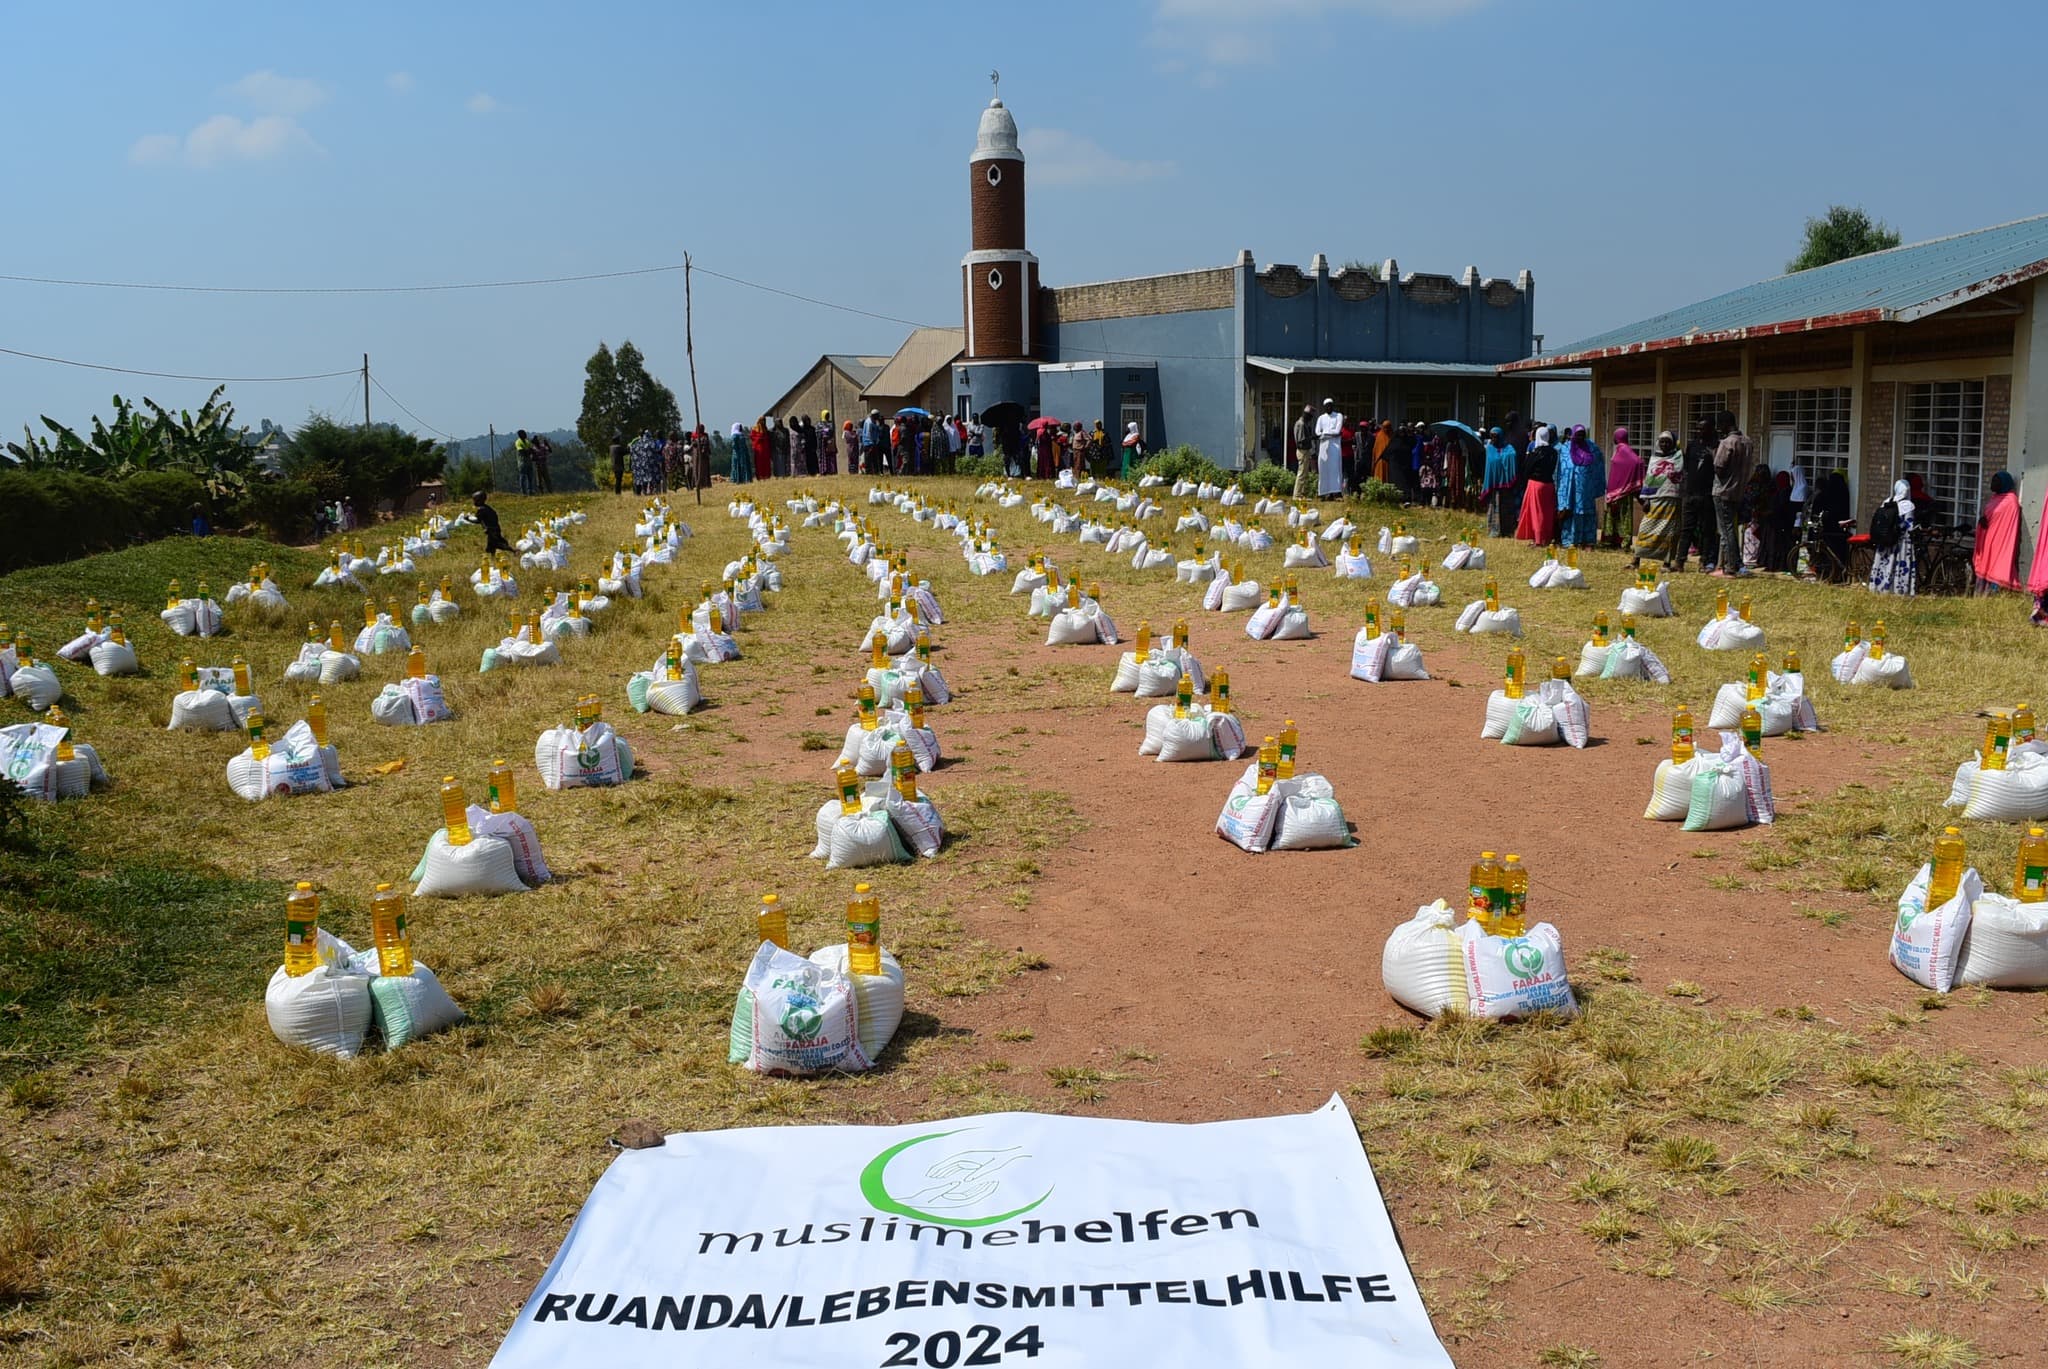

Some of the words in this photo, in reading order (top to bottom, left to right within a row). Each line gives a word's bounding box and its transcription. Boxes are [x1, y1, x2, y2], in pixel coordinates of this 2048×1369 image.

[1512, 972, 1553, 990] FARAJA
[784, 1036, 828, 1049] FARAJA
[699, 1209, 1259, 1254] muslimehelfen
[534, 1270, 1396, 1331] RUANDA/LEBENSMITTELHILFE
[879, 1324, 1044, 1369] 2024
